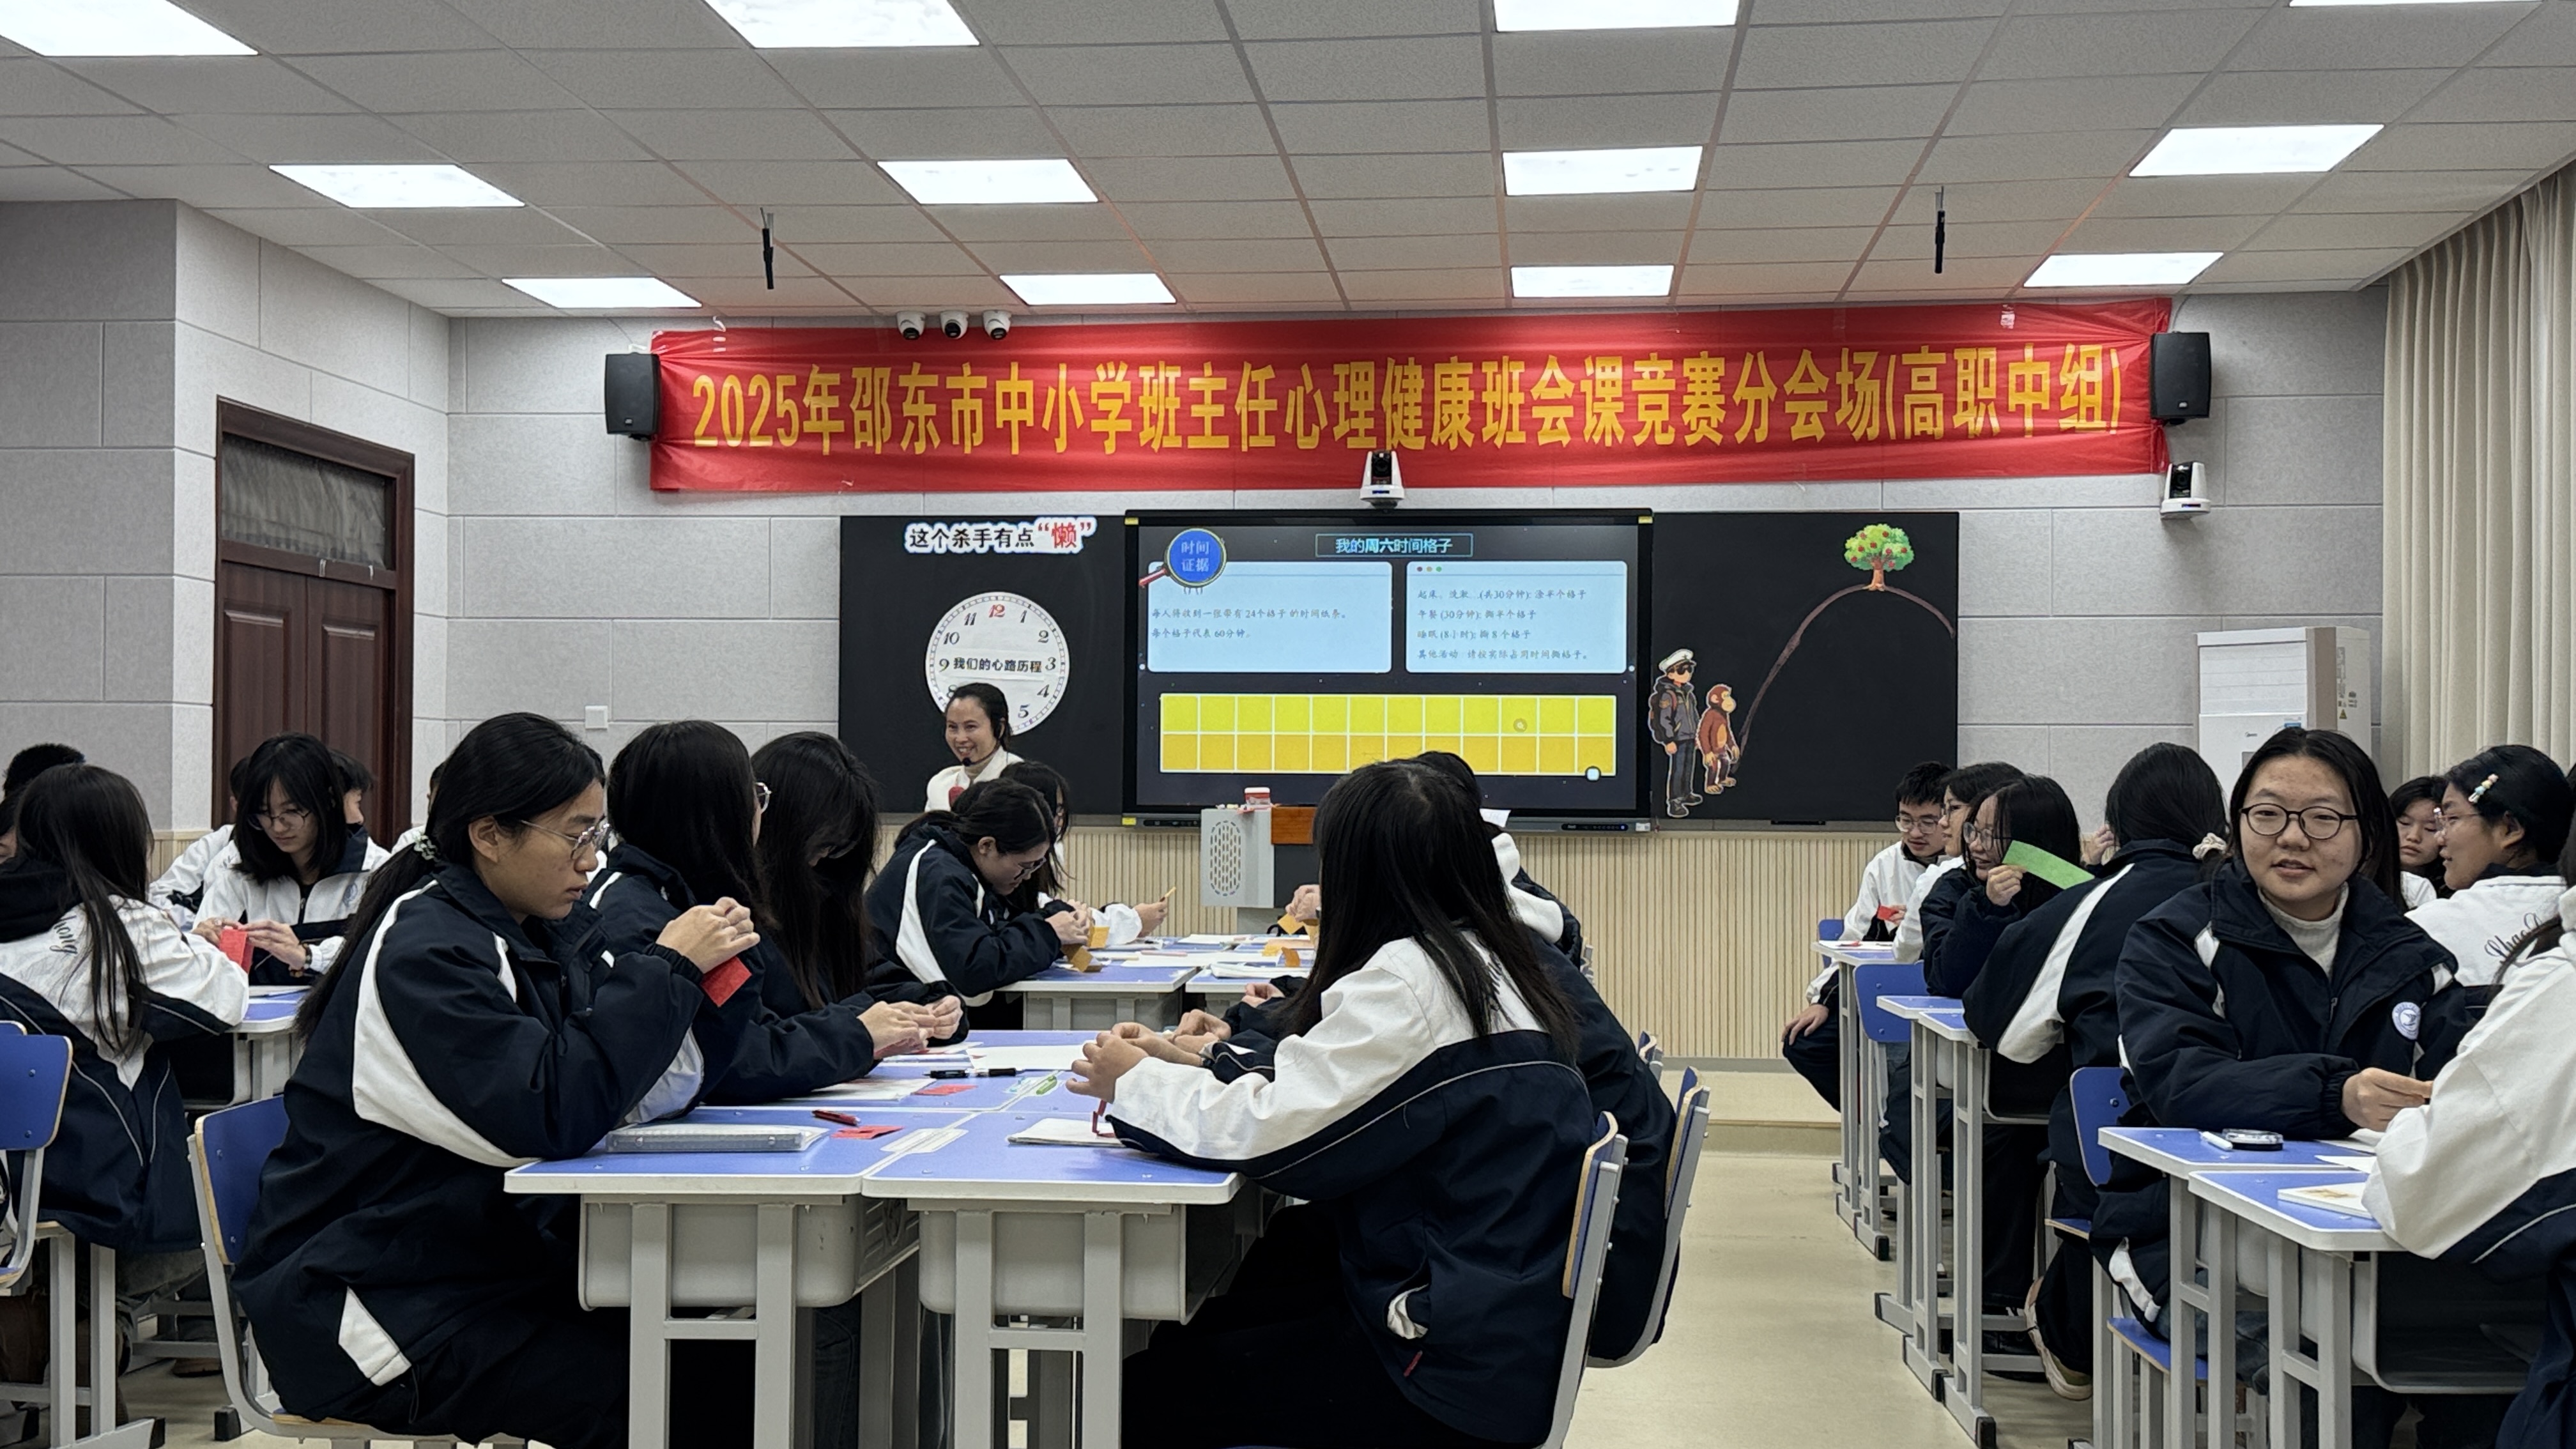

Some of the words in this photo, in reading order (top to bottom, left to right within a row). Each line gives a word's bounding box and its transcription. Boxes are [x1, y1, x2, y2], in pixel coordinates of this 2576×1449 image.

[692, 342, 2121, 456] 2025年邵东市中小学班主任心理健康班会课竞赛分会场(高职中组)
[909, 522, 1091, 549] 这个杀手有点“懒”
[1181, 540, 1209, 555] 时间
[1335, 538, 1453, 554] 我的周六时间格子
[1181, 557, 1209, 572] 证据
[988, 604, 1005, 618] 12
[1020, 610, 1027, 624] 1
[964, 612, 977, 625] 11
[943, 631, 960, 645] 10
[1038, 629, 1049, 643] 2
[939, 658, 950, 673] 9
[953, 657, 1042, 673] 我们的心路历程
[1045, 657, 1057, 671] 3
[946, 684, 958, 698] 8
[1036, 684, 1050, 698] 4
[1017, 703, 1031, 718] 5
